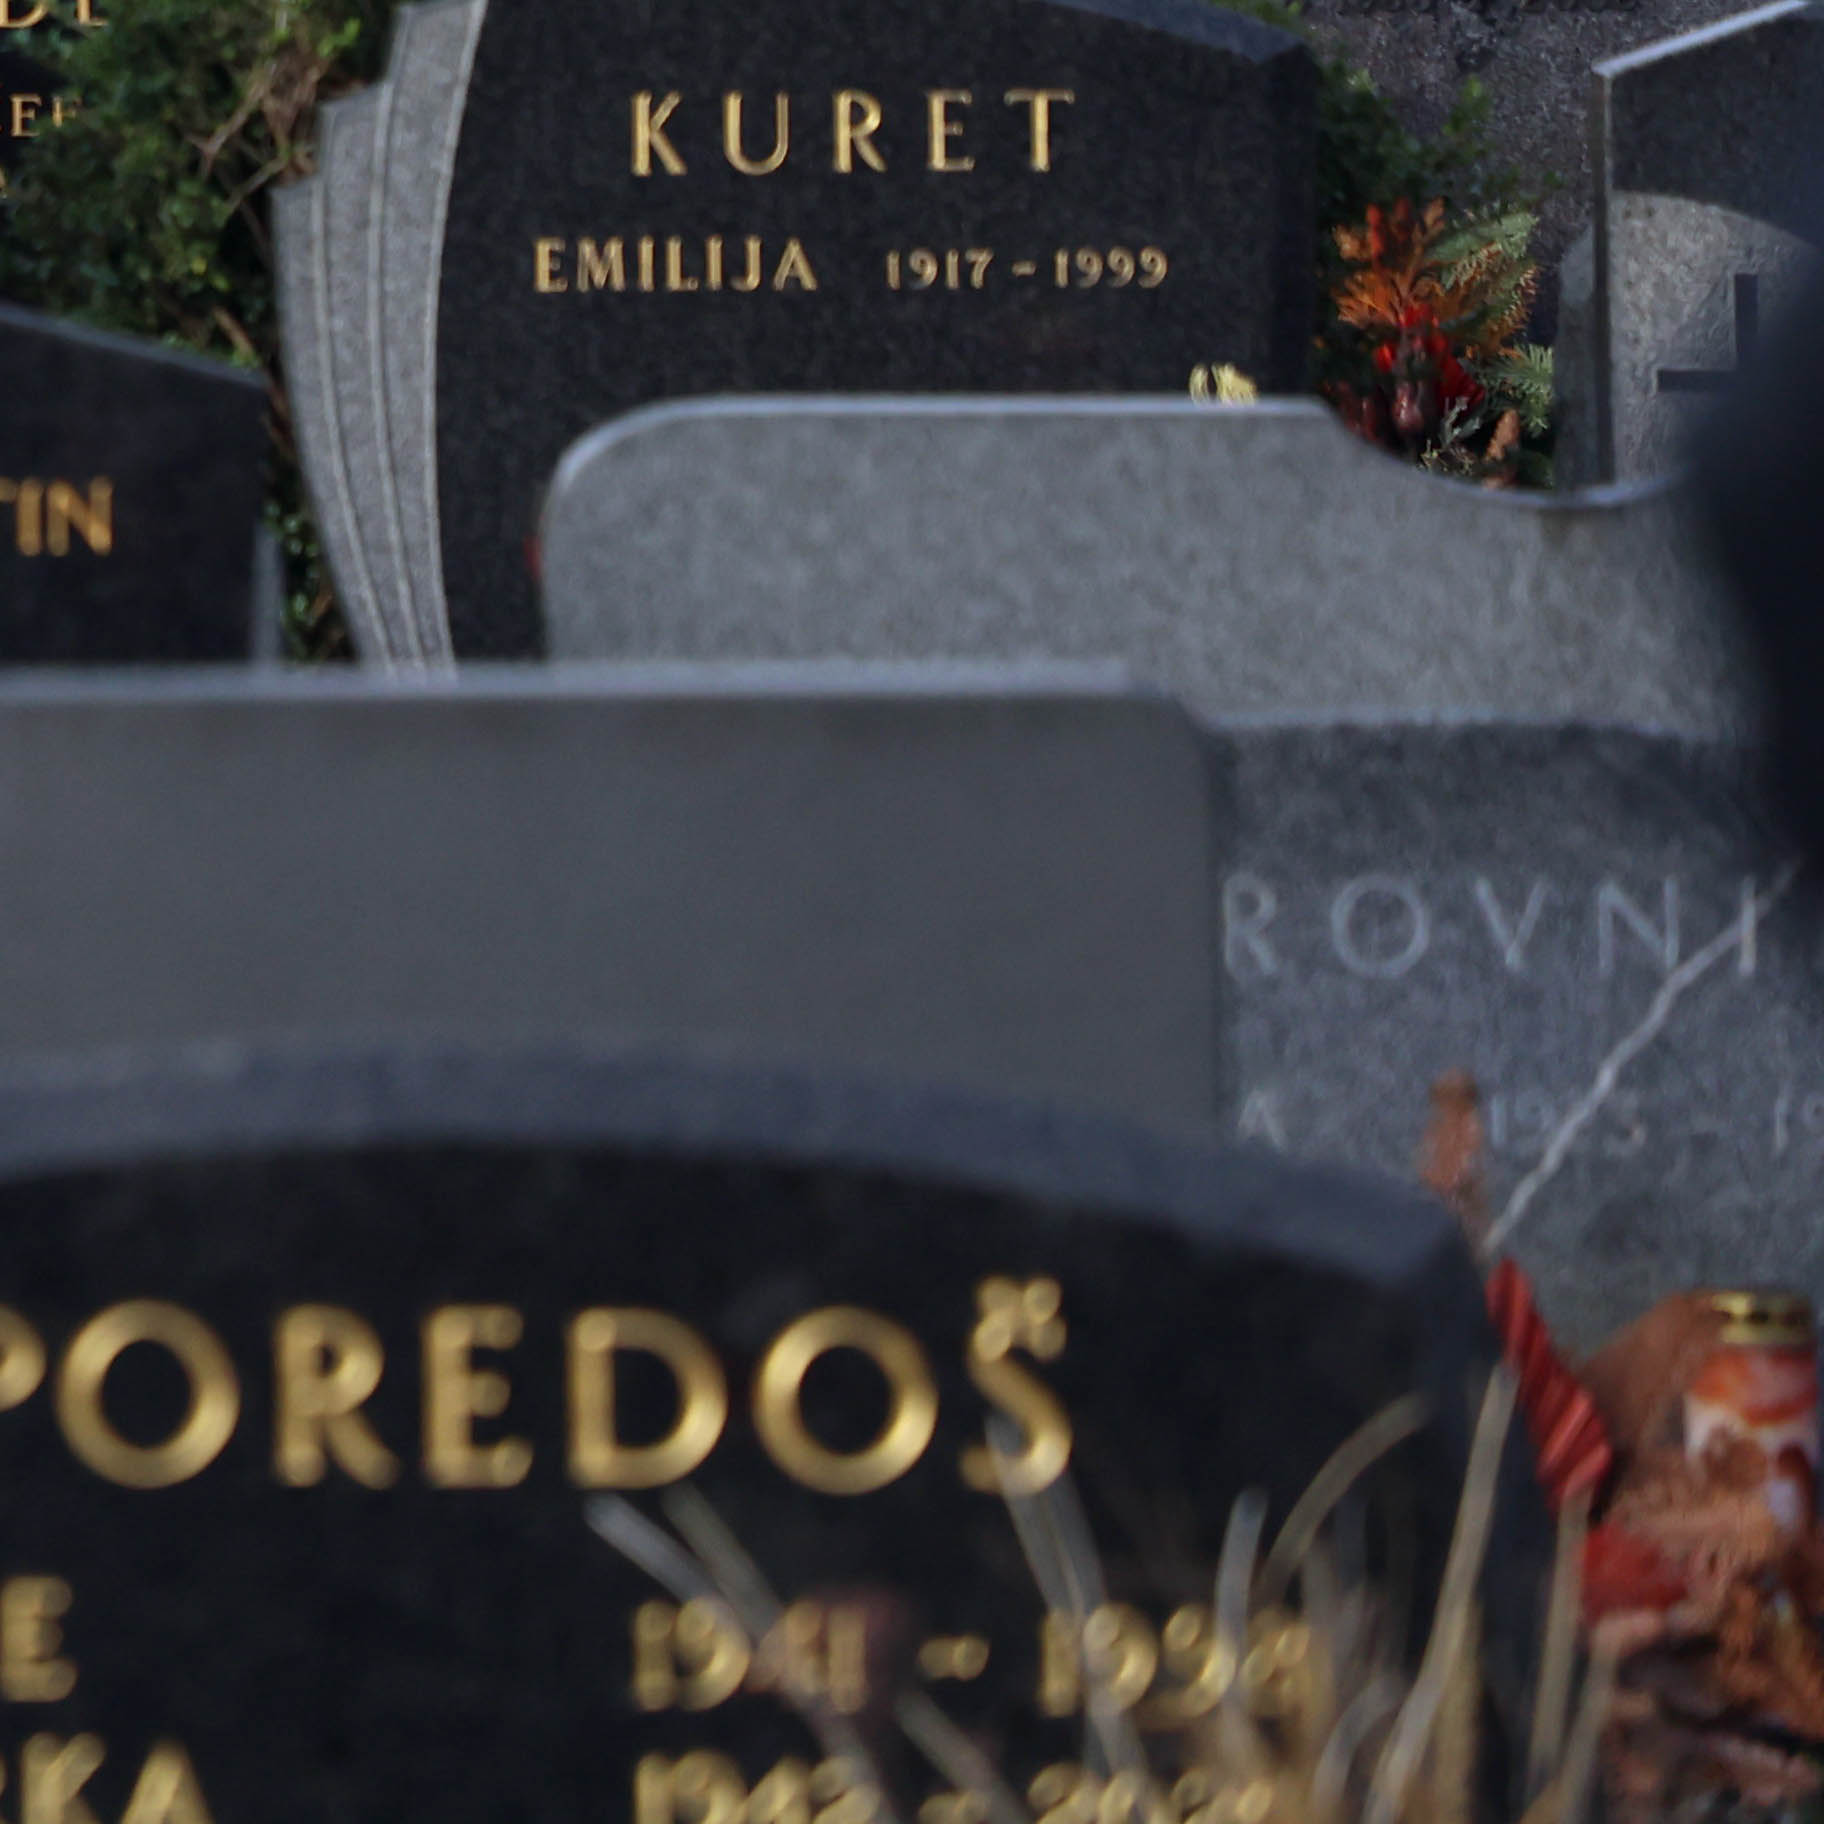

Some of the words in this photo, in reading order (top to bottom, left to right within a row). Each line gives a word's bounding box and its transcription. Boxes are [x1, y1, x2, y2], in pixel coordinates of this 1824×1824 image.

[631, 88, 1076, 176] KURET
[533, 236, 819, 293] EMILIJA
[885, 247, 992, 290] 1917
[1054, 246, 1168, 290] 1999
